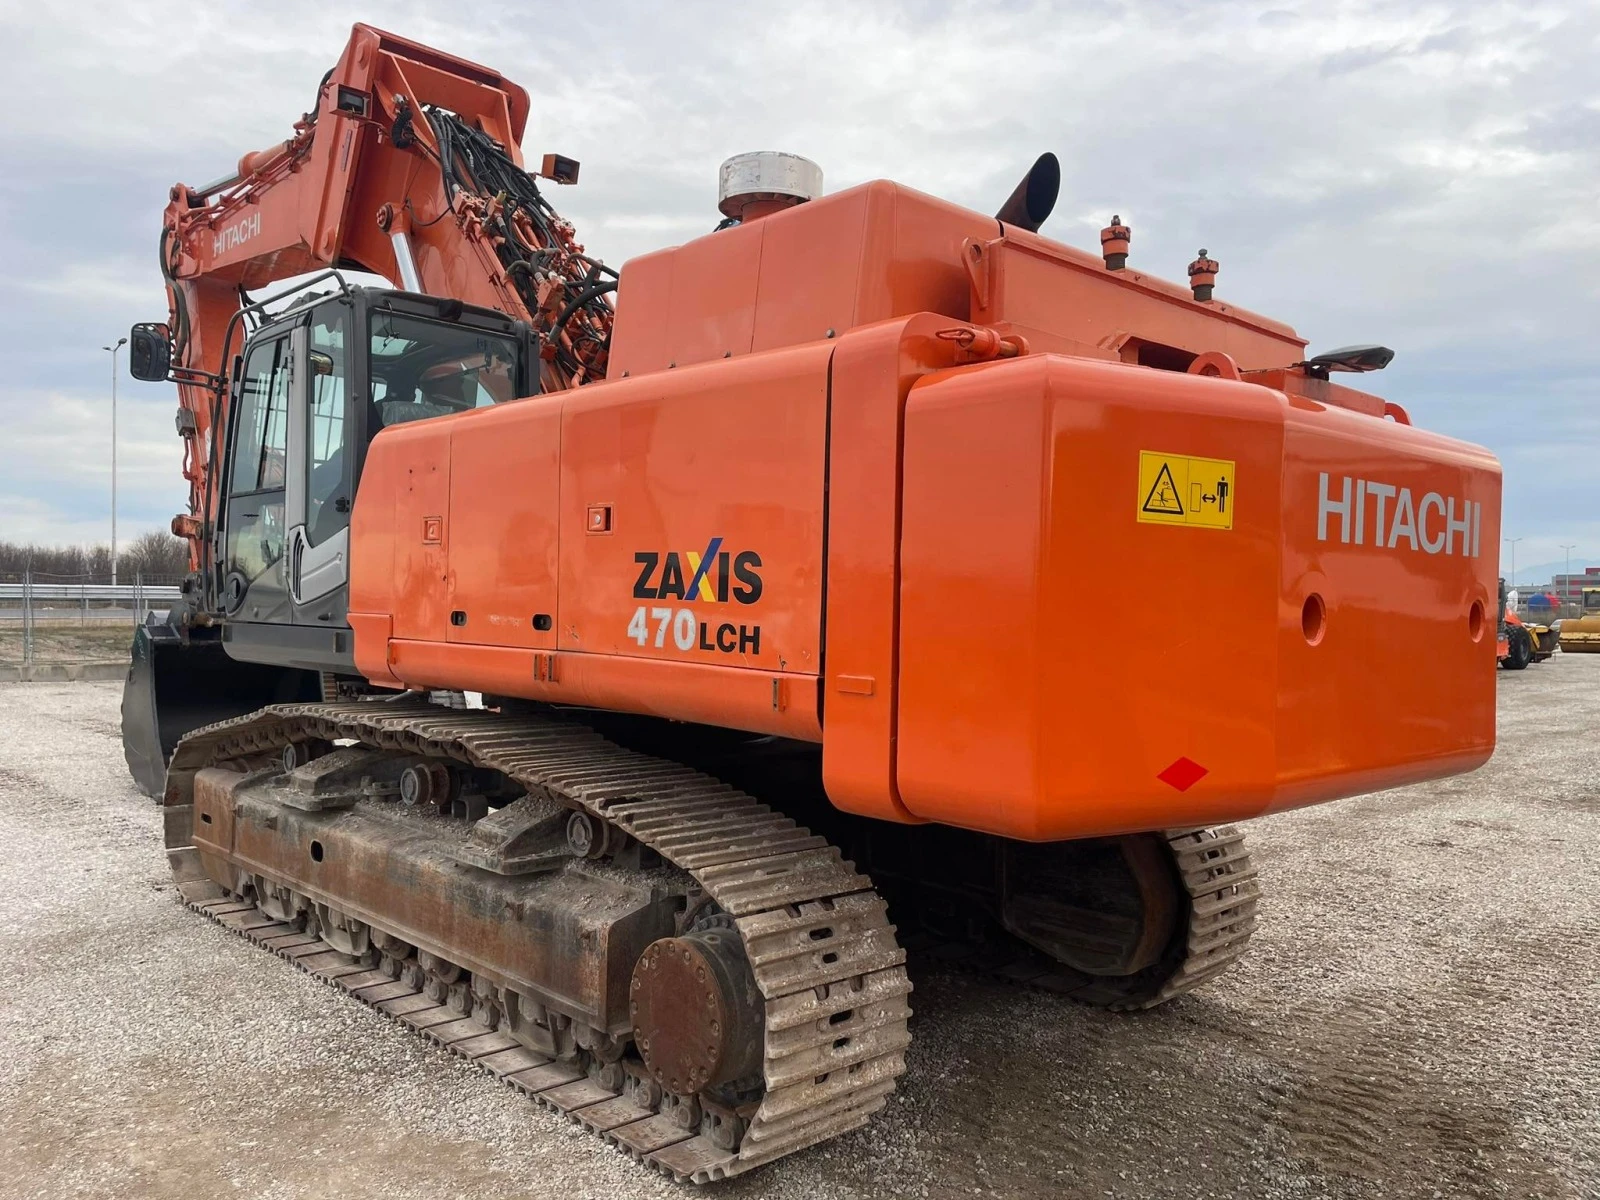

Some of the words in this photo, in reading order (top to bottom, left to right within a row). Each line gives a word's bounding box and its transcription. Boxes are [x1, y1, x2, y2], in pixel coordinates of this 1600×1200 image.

[213, 212, 261, 258] HITACHI
[1317, 472, 1481, 558] HITACHI
[633, 537, 763, 605] ZAXIS
